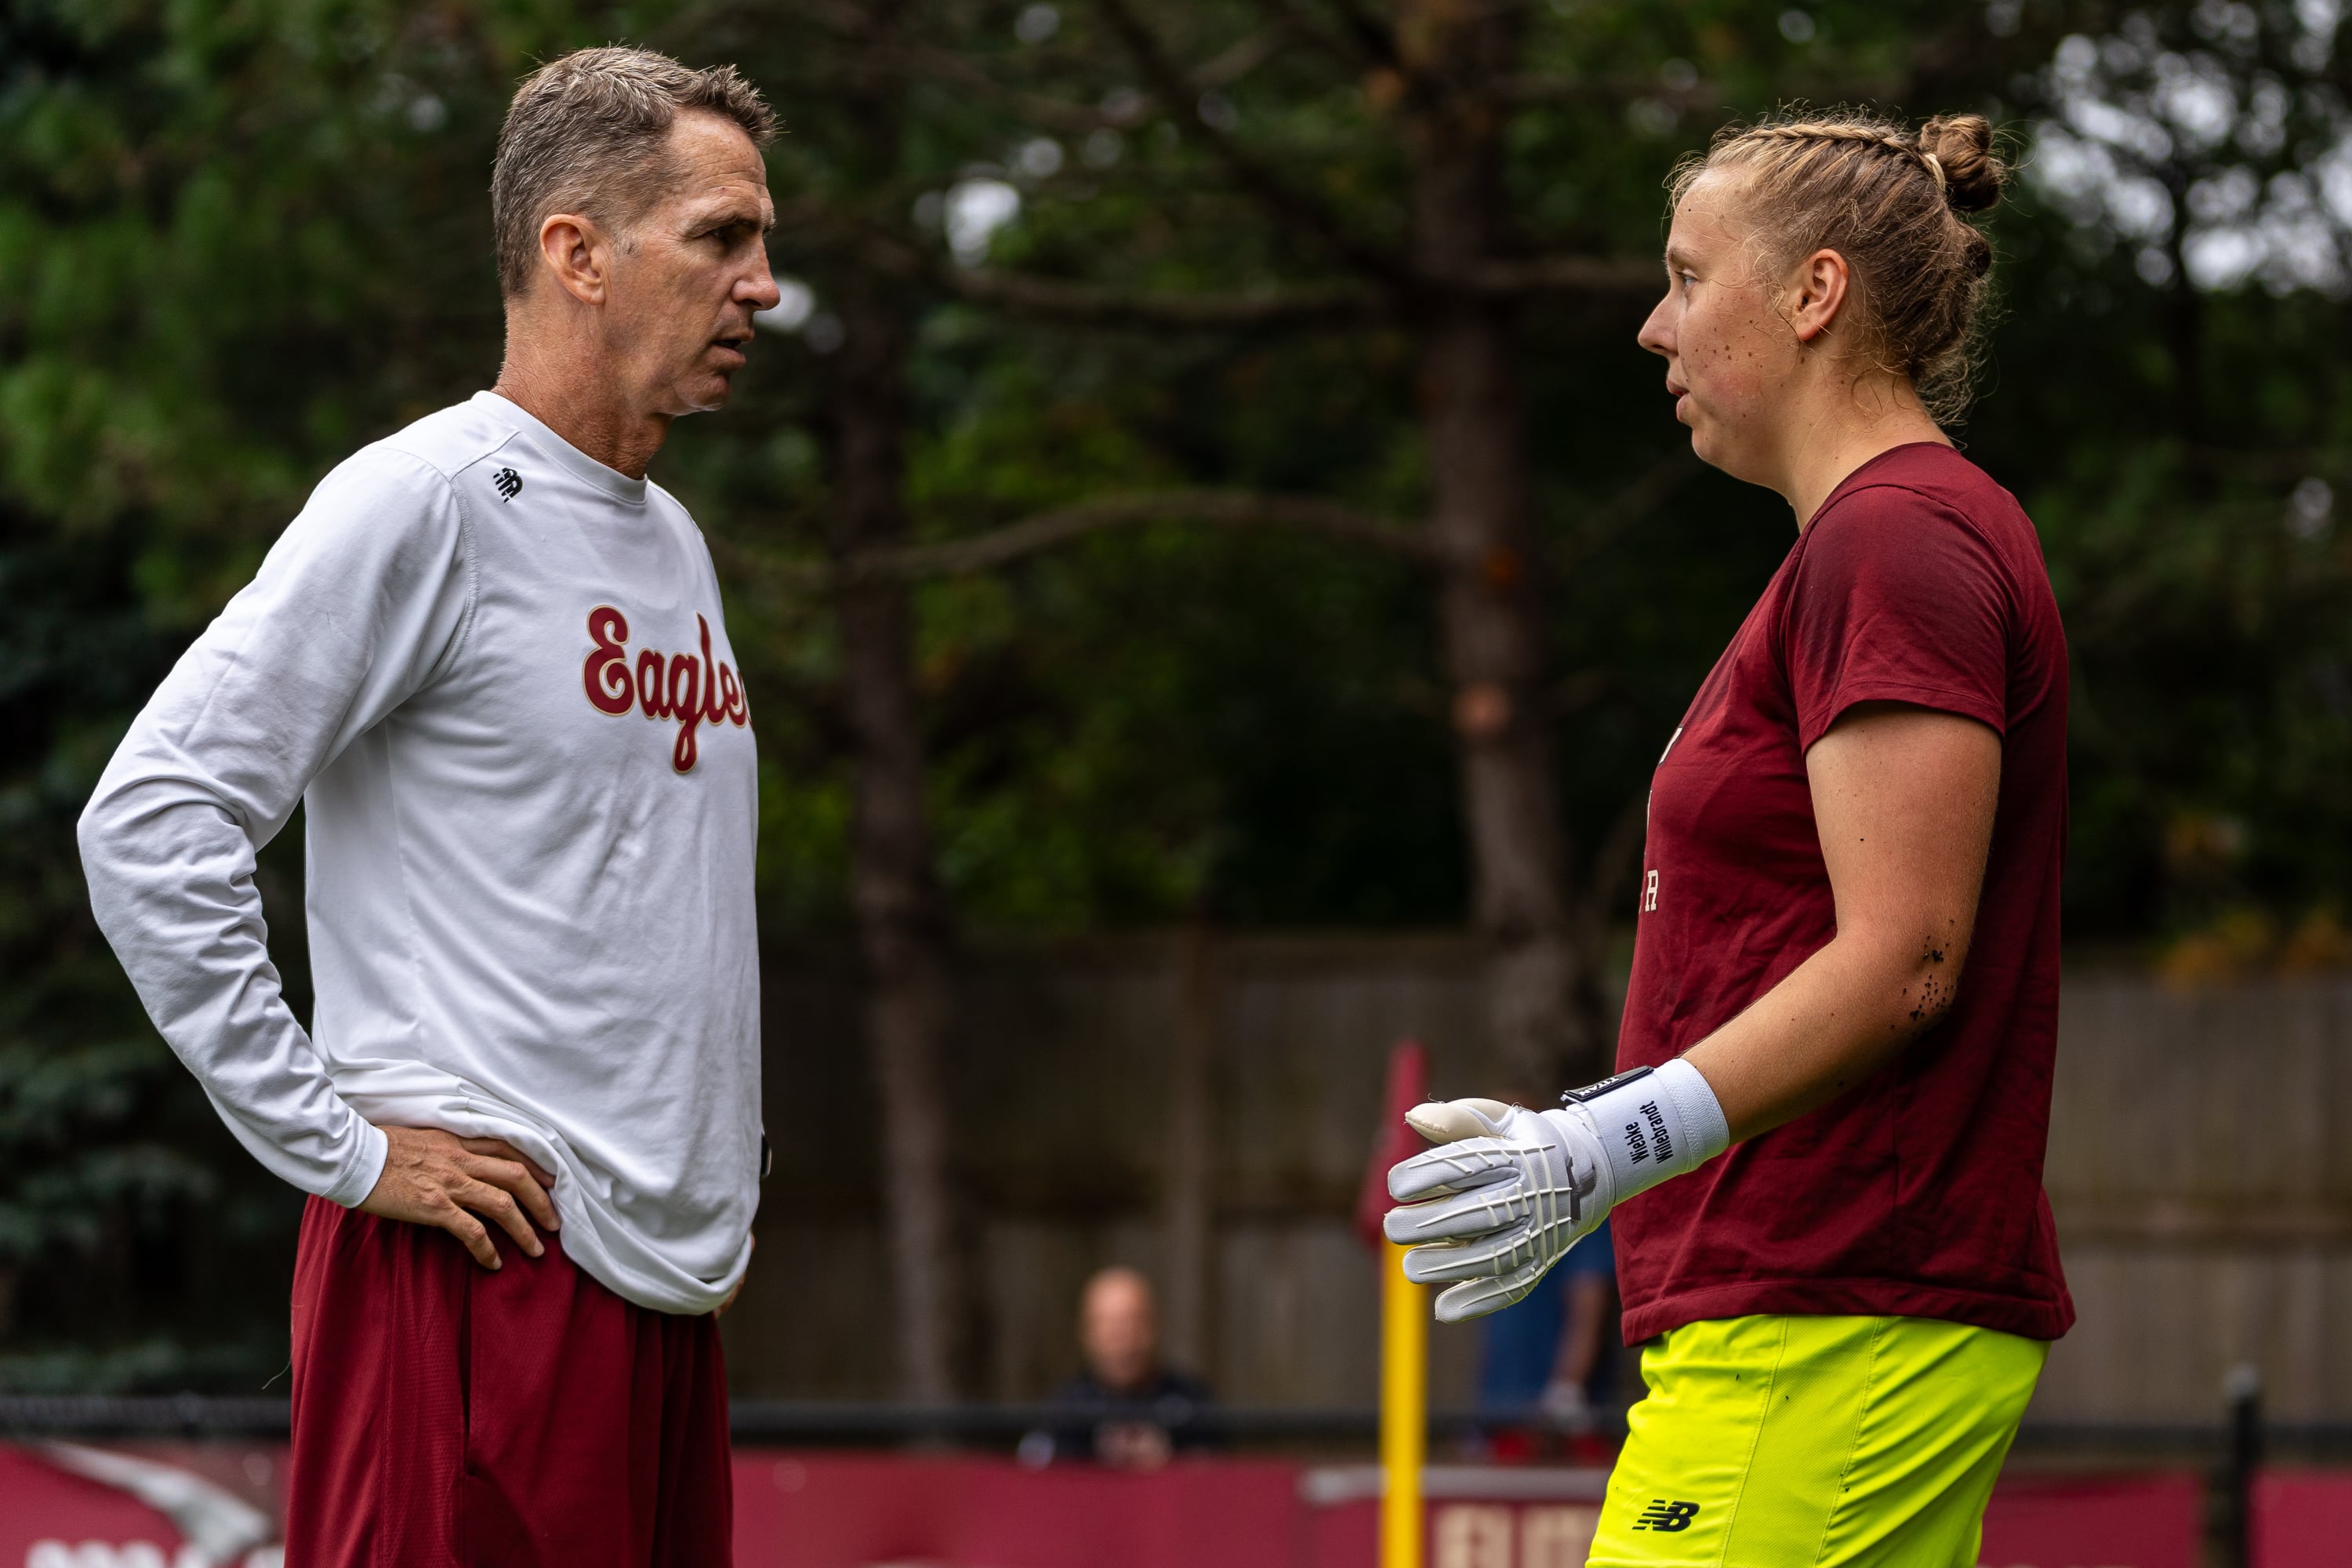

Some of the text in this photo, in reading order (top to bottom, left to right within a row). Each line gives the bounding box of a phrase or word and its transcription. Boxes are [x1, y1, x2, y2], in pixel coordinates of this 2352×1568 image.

[583, 604, 754, 774] Eagle
[1624, 1121, 1650, 1165] Wiebke
[1639, 1100, 1674, 1164] Willebrandt
